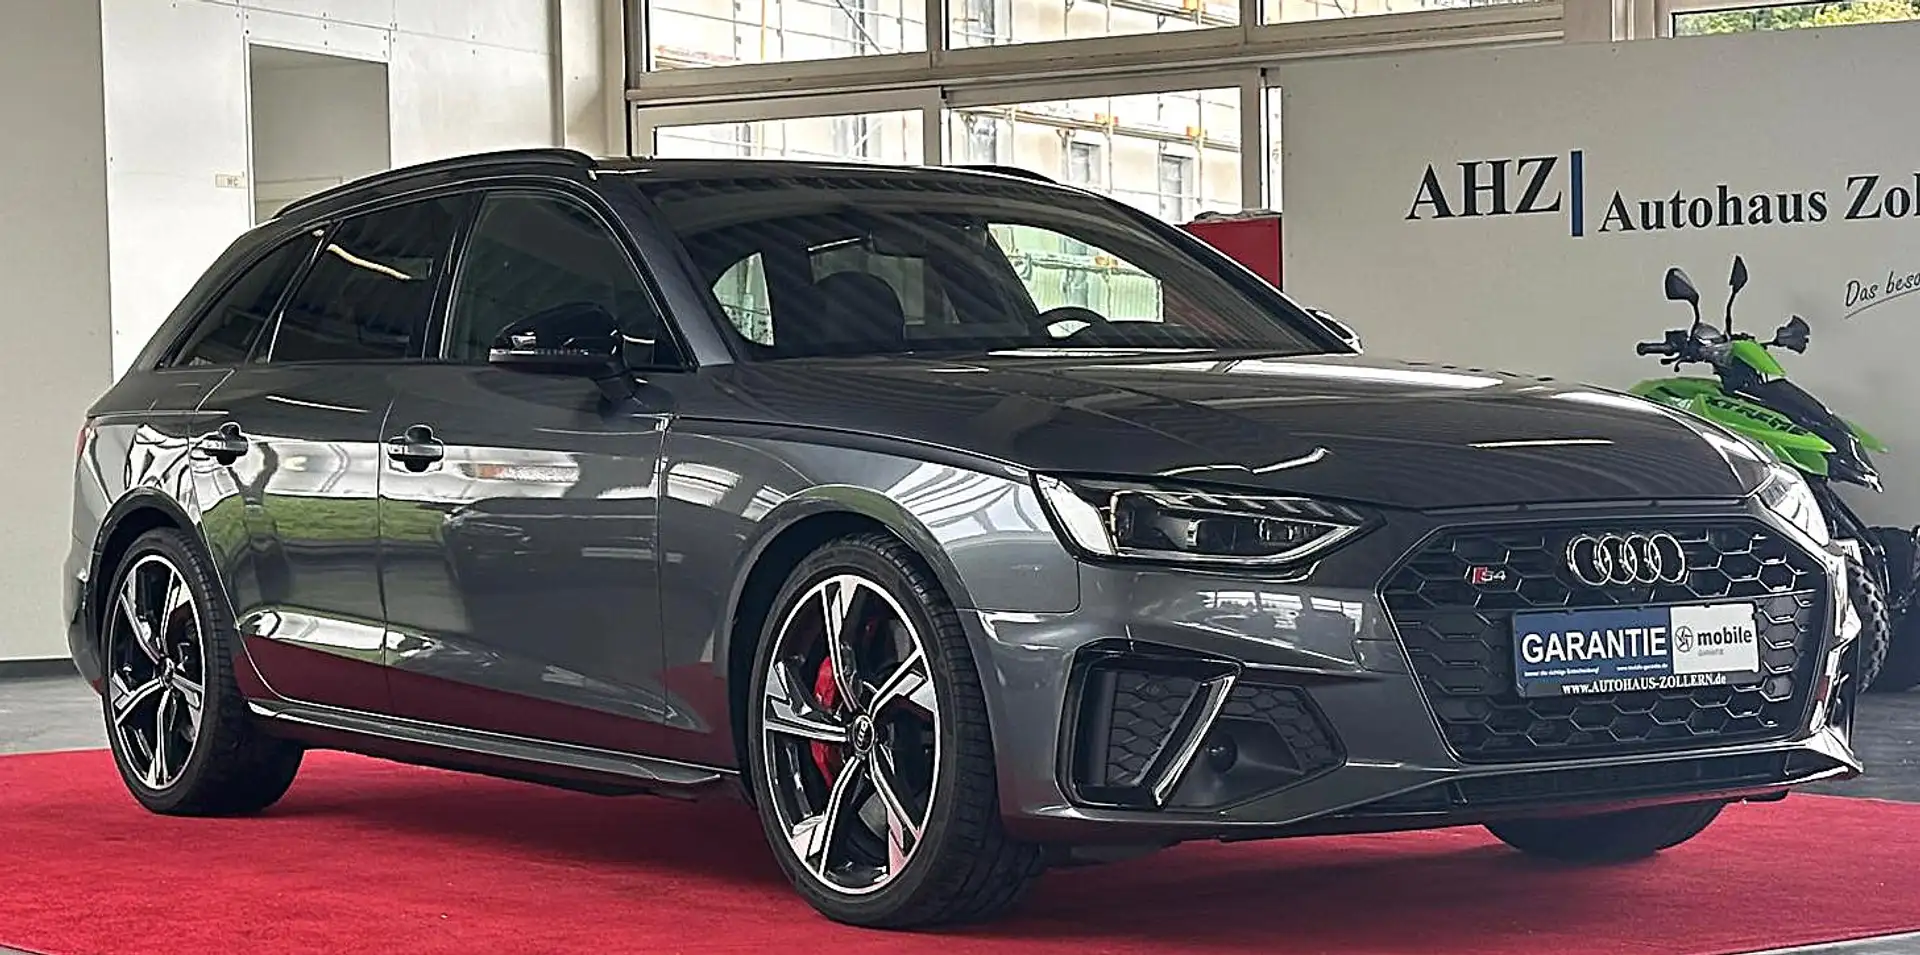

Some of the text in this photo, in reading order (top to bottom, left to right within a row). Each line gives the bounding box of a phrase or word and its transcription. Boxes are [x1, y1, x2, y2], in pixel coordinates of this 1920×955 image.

[1405, 156, 1563, 221] AHZ
[1598, 185, 1828, 232] Autohaus
[1846, 280, 1878, 307] Das
[1522, 626, 1753, 663] GARANTIE mobile
[1562, 673, 1727, 694] www.AUTOHAUS-ZOLLERN.de
